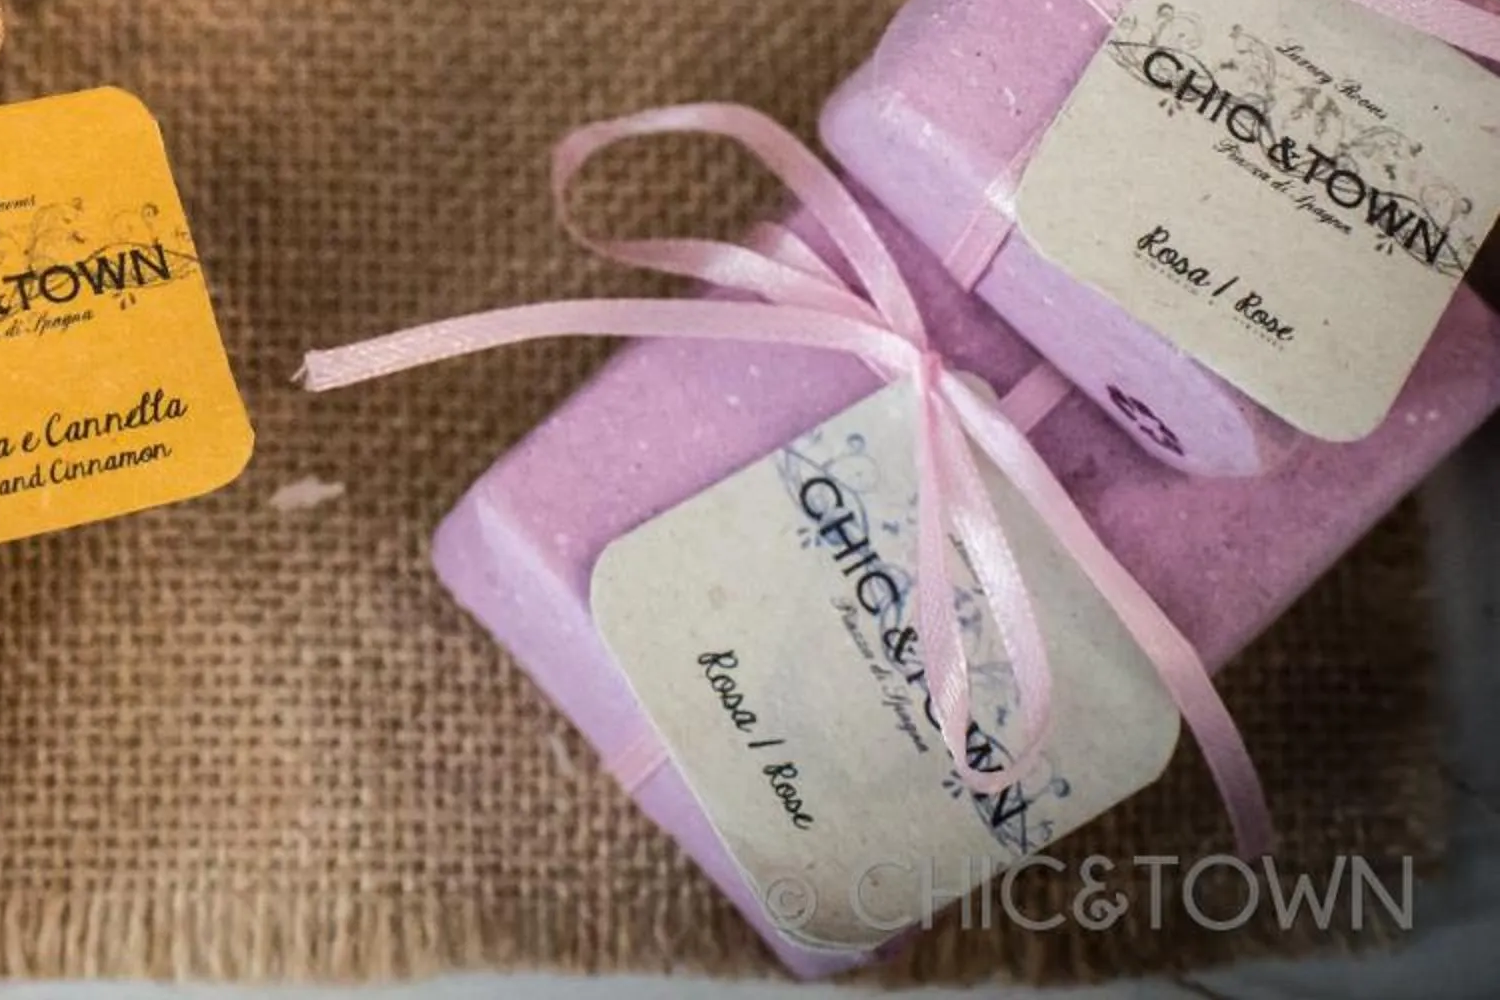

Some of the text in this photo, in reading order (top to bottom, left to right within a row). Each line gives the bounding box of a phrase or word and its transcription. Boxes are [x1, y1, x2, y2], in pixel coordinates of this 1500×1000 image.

[1143, 49, 1267, 144] CHIC
[1136, 225, 1212, 287] Rosa
[1233, 290, 1295, 342] Rose
[0, 464, 47, 497] and
[49, 442, 172, 485] Cinnamon
[21, 431, 41, 454] e
[45, 388, 188, 449] Cannella
[799, 476, 900, 616] CHIC
[697, 649, 757, 734] Rosa
[762, 761, 815, 831] Rose
